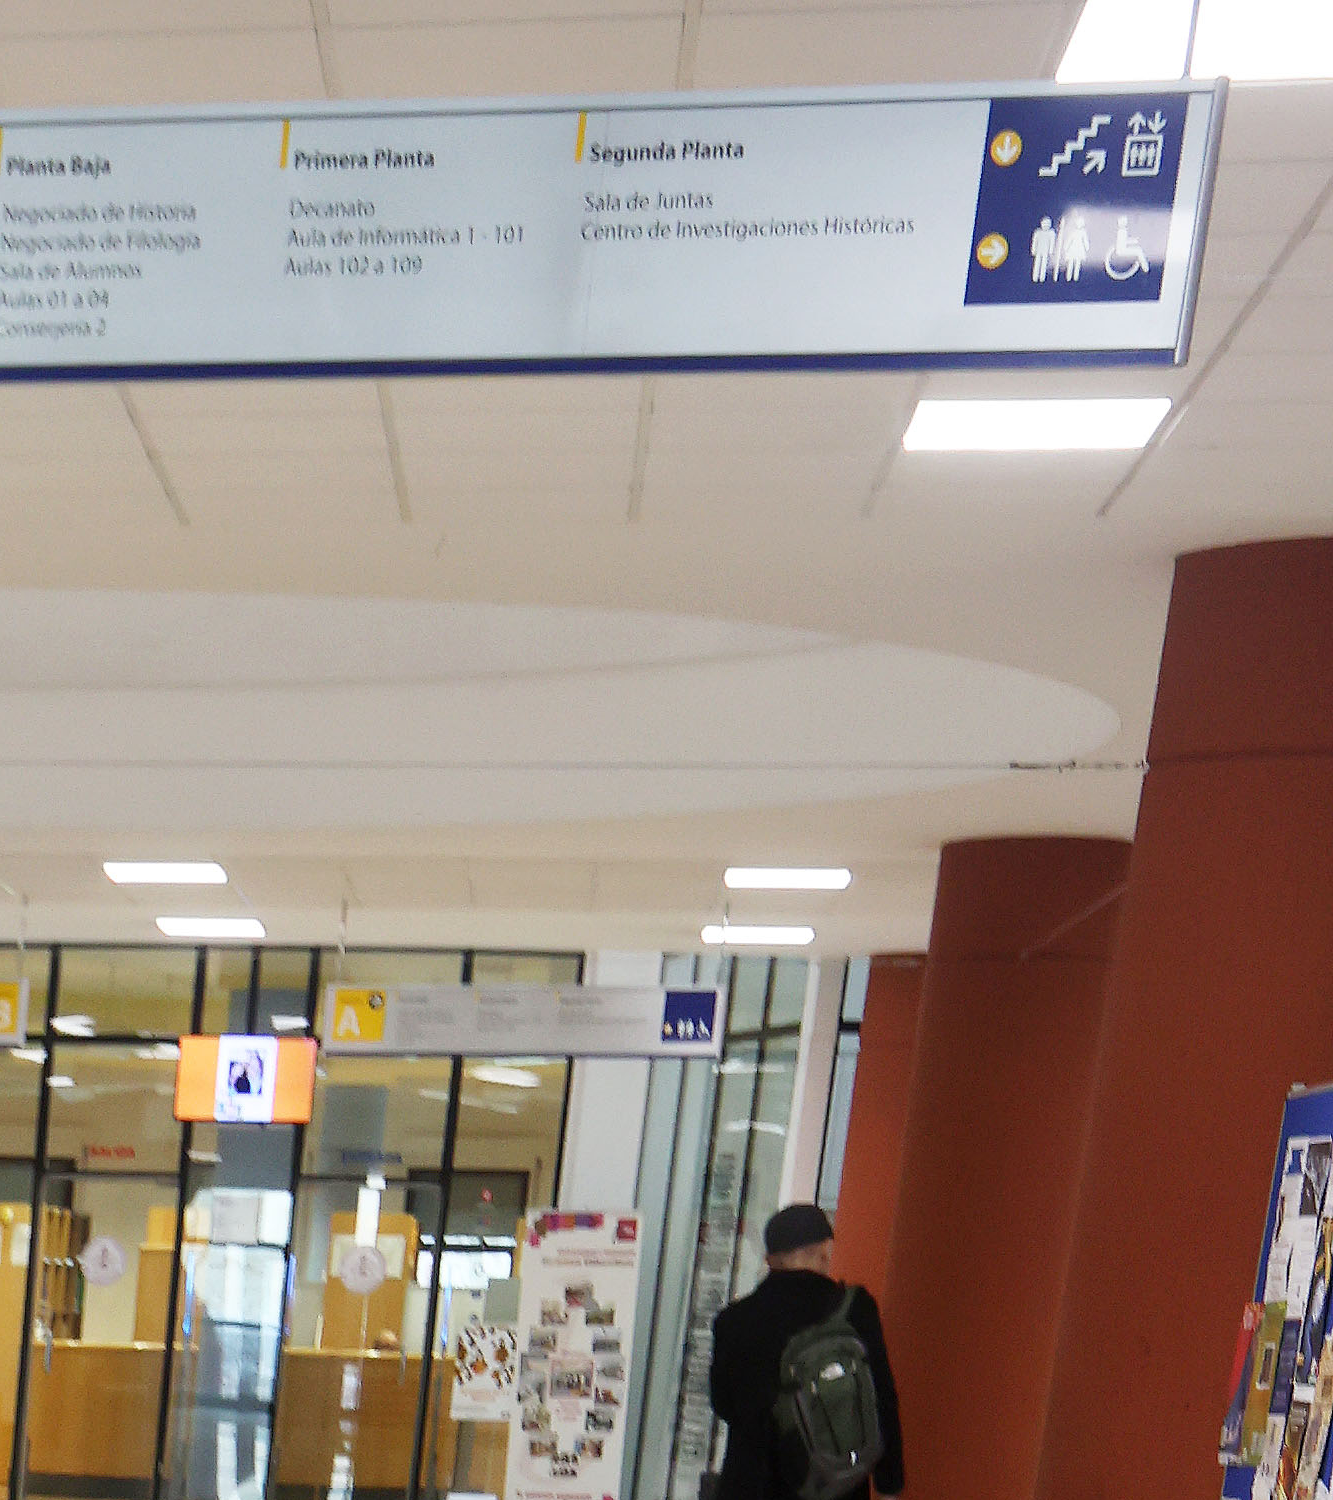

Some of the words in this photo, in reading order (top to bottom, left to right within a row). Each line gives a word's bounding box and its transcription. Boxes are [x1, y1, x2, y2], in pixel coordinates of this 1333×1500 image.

[293, 150, 368, 170] Primera
[374, 148, 435, 169] Planta
[589, 141, 676, 167] Segunda
[682, 139, 745, 160] Planta
[5, 156, 65, 177] Planta
[71, 154, 112, 180] Baja
[289, 199, 375, 219] Decanato
[584, 192, 621, 213] Sala
[626, 192, 650, 211] de
[657, 190, 714, 210] Juntas
[2, 202, 97, 228] Negociado
[101, 201, 126, 222] de
[129, 200, 198, 223] Historia
[288, 228, 326, 247] Aula
[332, 228, 354, 247] de
[495, 224, 524, 245] 101
[581, 221, 642, 241] Centro
[647, 219, 671, 239] de
[675, 217, 818, 242] Investigaciones
[824, 215, 915, 236] Históricas
[0, 231, 96, 256] Negociado
[100, 230, 124, 252] de
[37, 261, 60, 281] de
[66, 259, 142, 281] Alumnos
[285, 257, 333, 277] Aulas
[340, 255, 369, 275] 102
[374, 260, 384, 275] a
[391, 254, 423, 275] 109
[46, 290, 68, 310] 01
[87, 290, 110, 310] 04
[95, 318, 107, 338] 2
[338, 1004, 361, 1036] A
